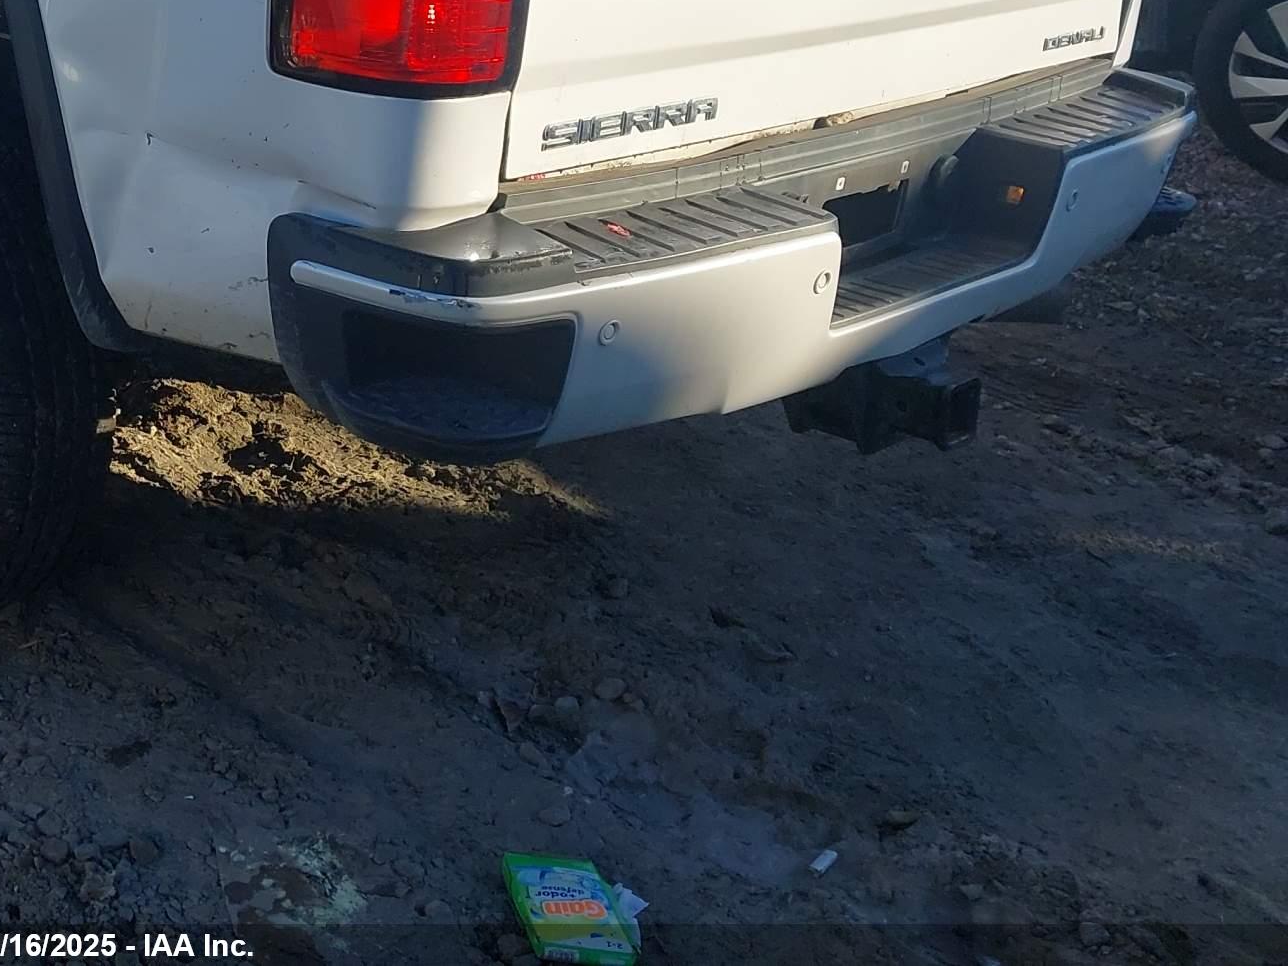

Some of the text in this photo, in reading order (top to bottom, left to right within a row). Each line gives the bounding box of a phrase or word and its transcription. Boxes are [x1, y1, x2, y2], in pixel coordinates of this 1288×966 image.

[1043, 26, 1106, 52] DENALI
[541, 97, 719, 151] SIERRA
[544, 901, 606, 918] Gain
